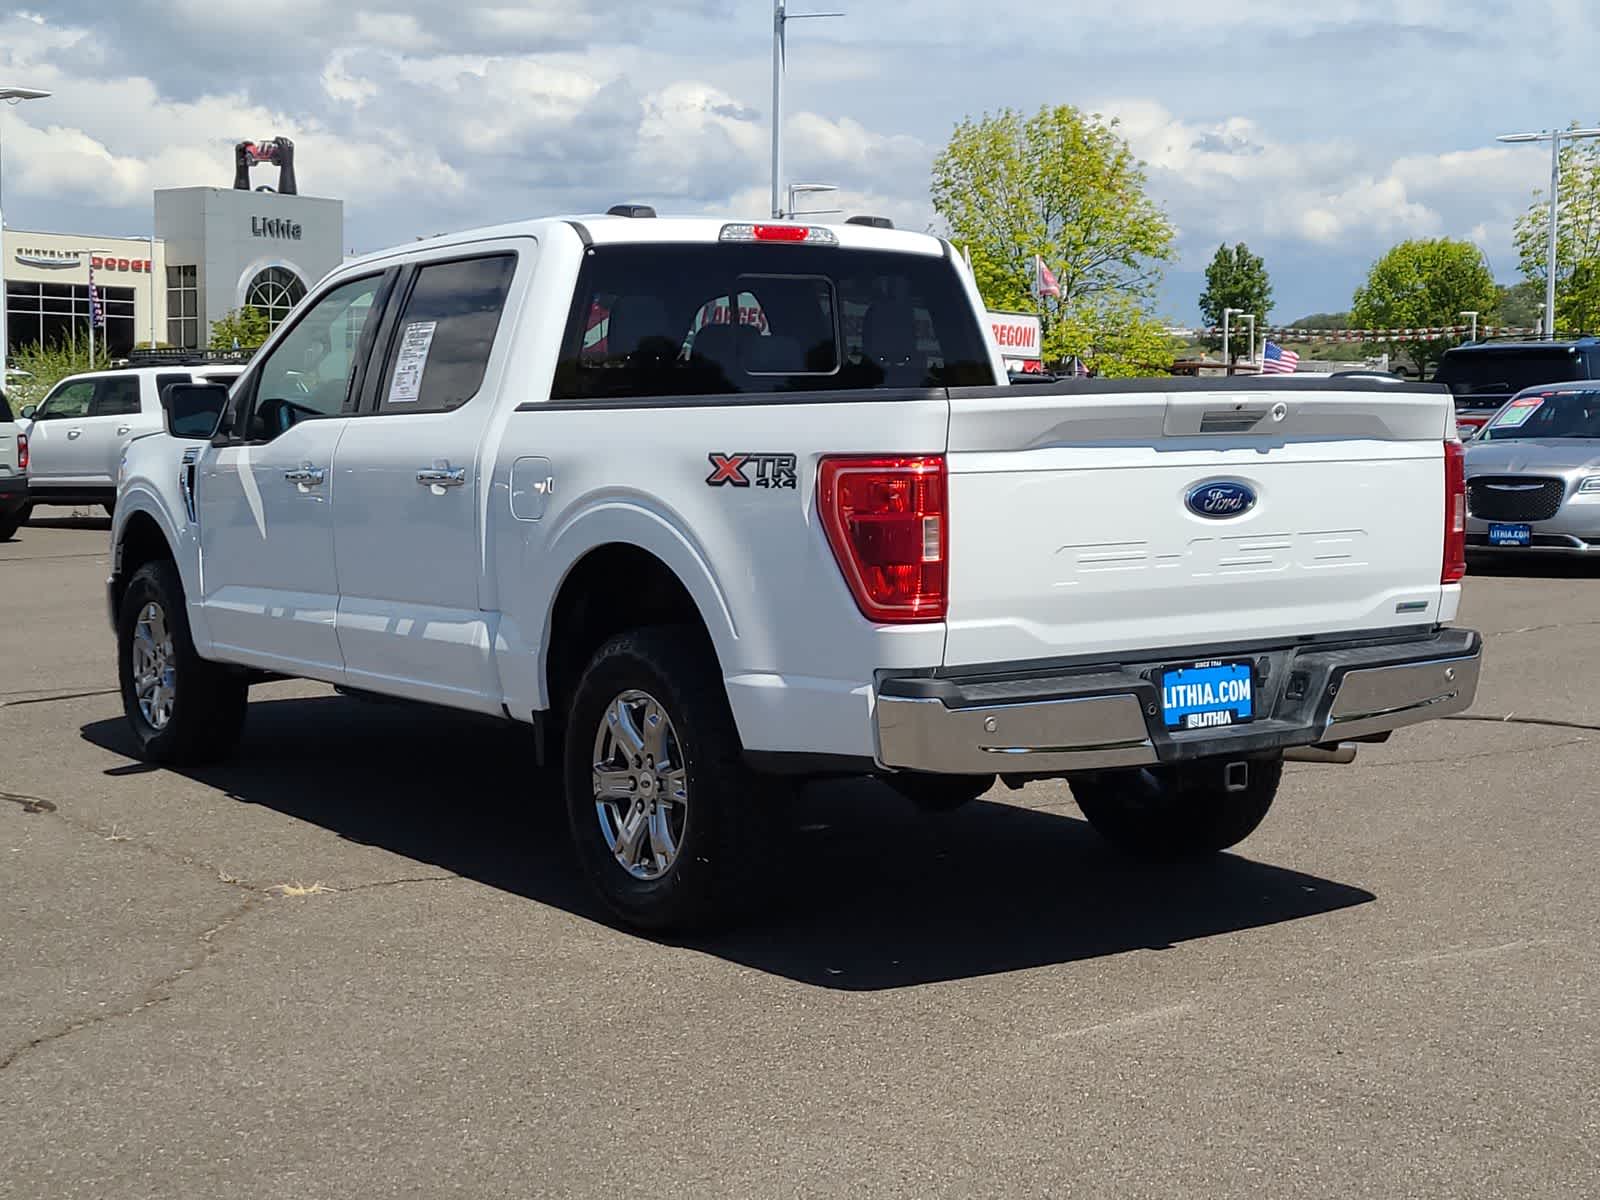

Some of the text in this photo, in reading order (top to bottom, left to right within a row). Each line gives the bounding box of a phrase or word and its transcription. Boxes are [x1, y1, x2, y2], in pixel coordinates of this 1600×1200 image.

[251, 215, 302, 240] Lithia
[91, 256, 152, 273] DODGE
[1204, 488, 1243, 511] Ford
[1490, 529, 1530, 539] LITHIA.COM
[1163, 679, 1251, 709] LITHIA.COM
[1198, 710, 1232, 726] LITHIA
